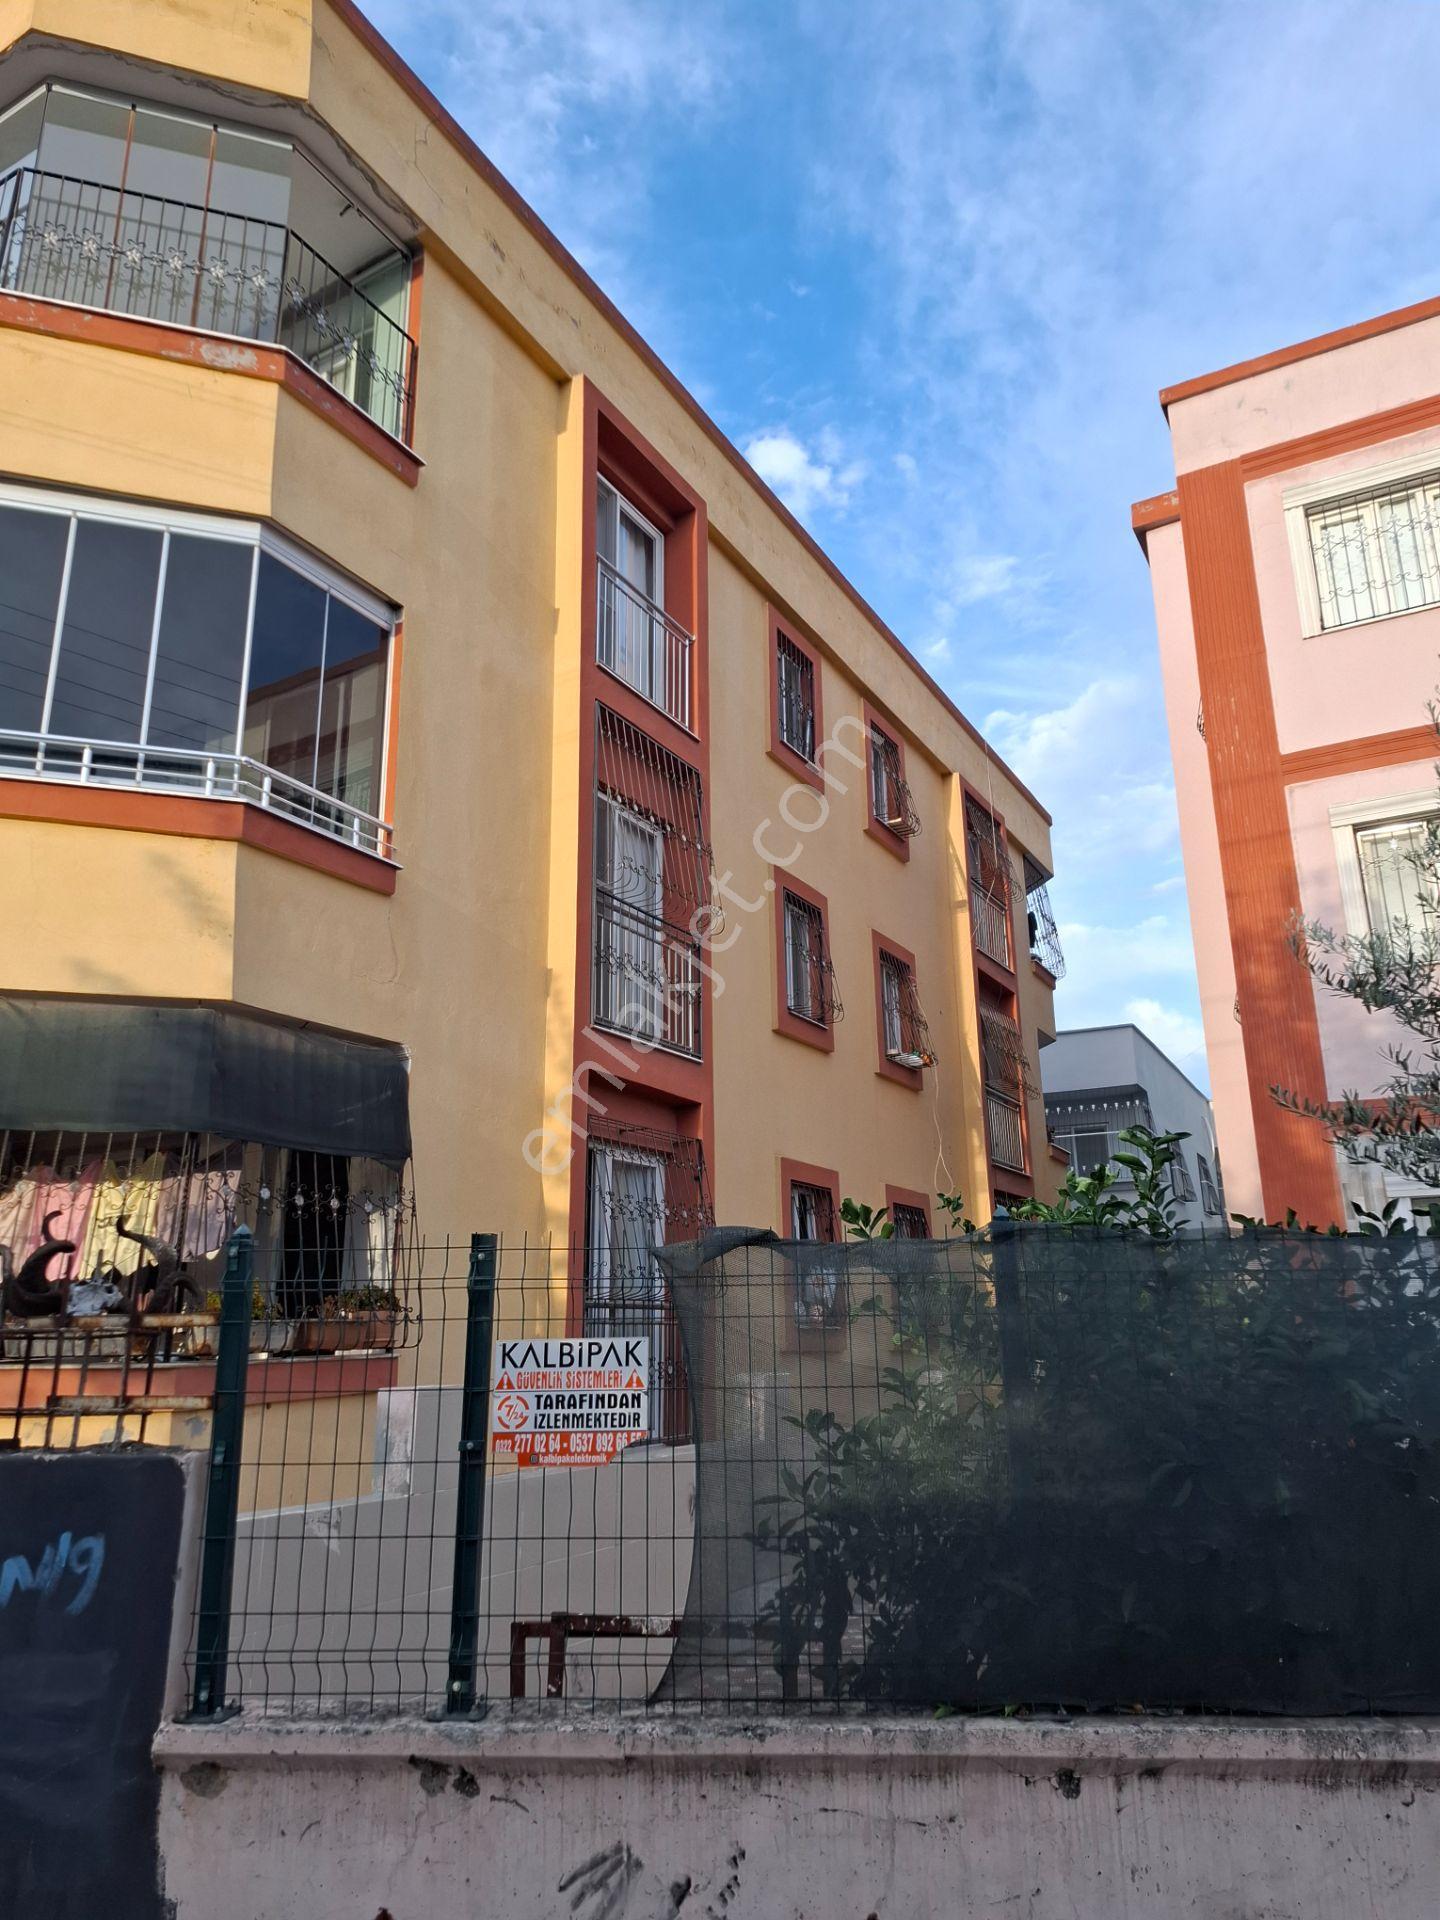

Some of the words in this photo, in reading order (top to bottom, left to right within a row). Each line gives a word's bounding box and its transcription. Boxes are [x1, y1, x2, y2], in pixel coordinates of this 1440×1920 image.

[534, 1393, 641, 1410] TARAFINDAN
[514, 1433, 532, 1453] 277
[549, 1433, 560, 1453] 64
[570, 1432, 593, 1453] 0537
